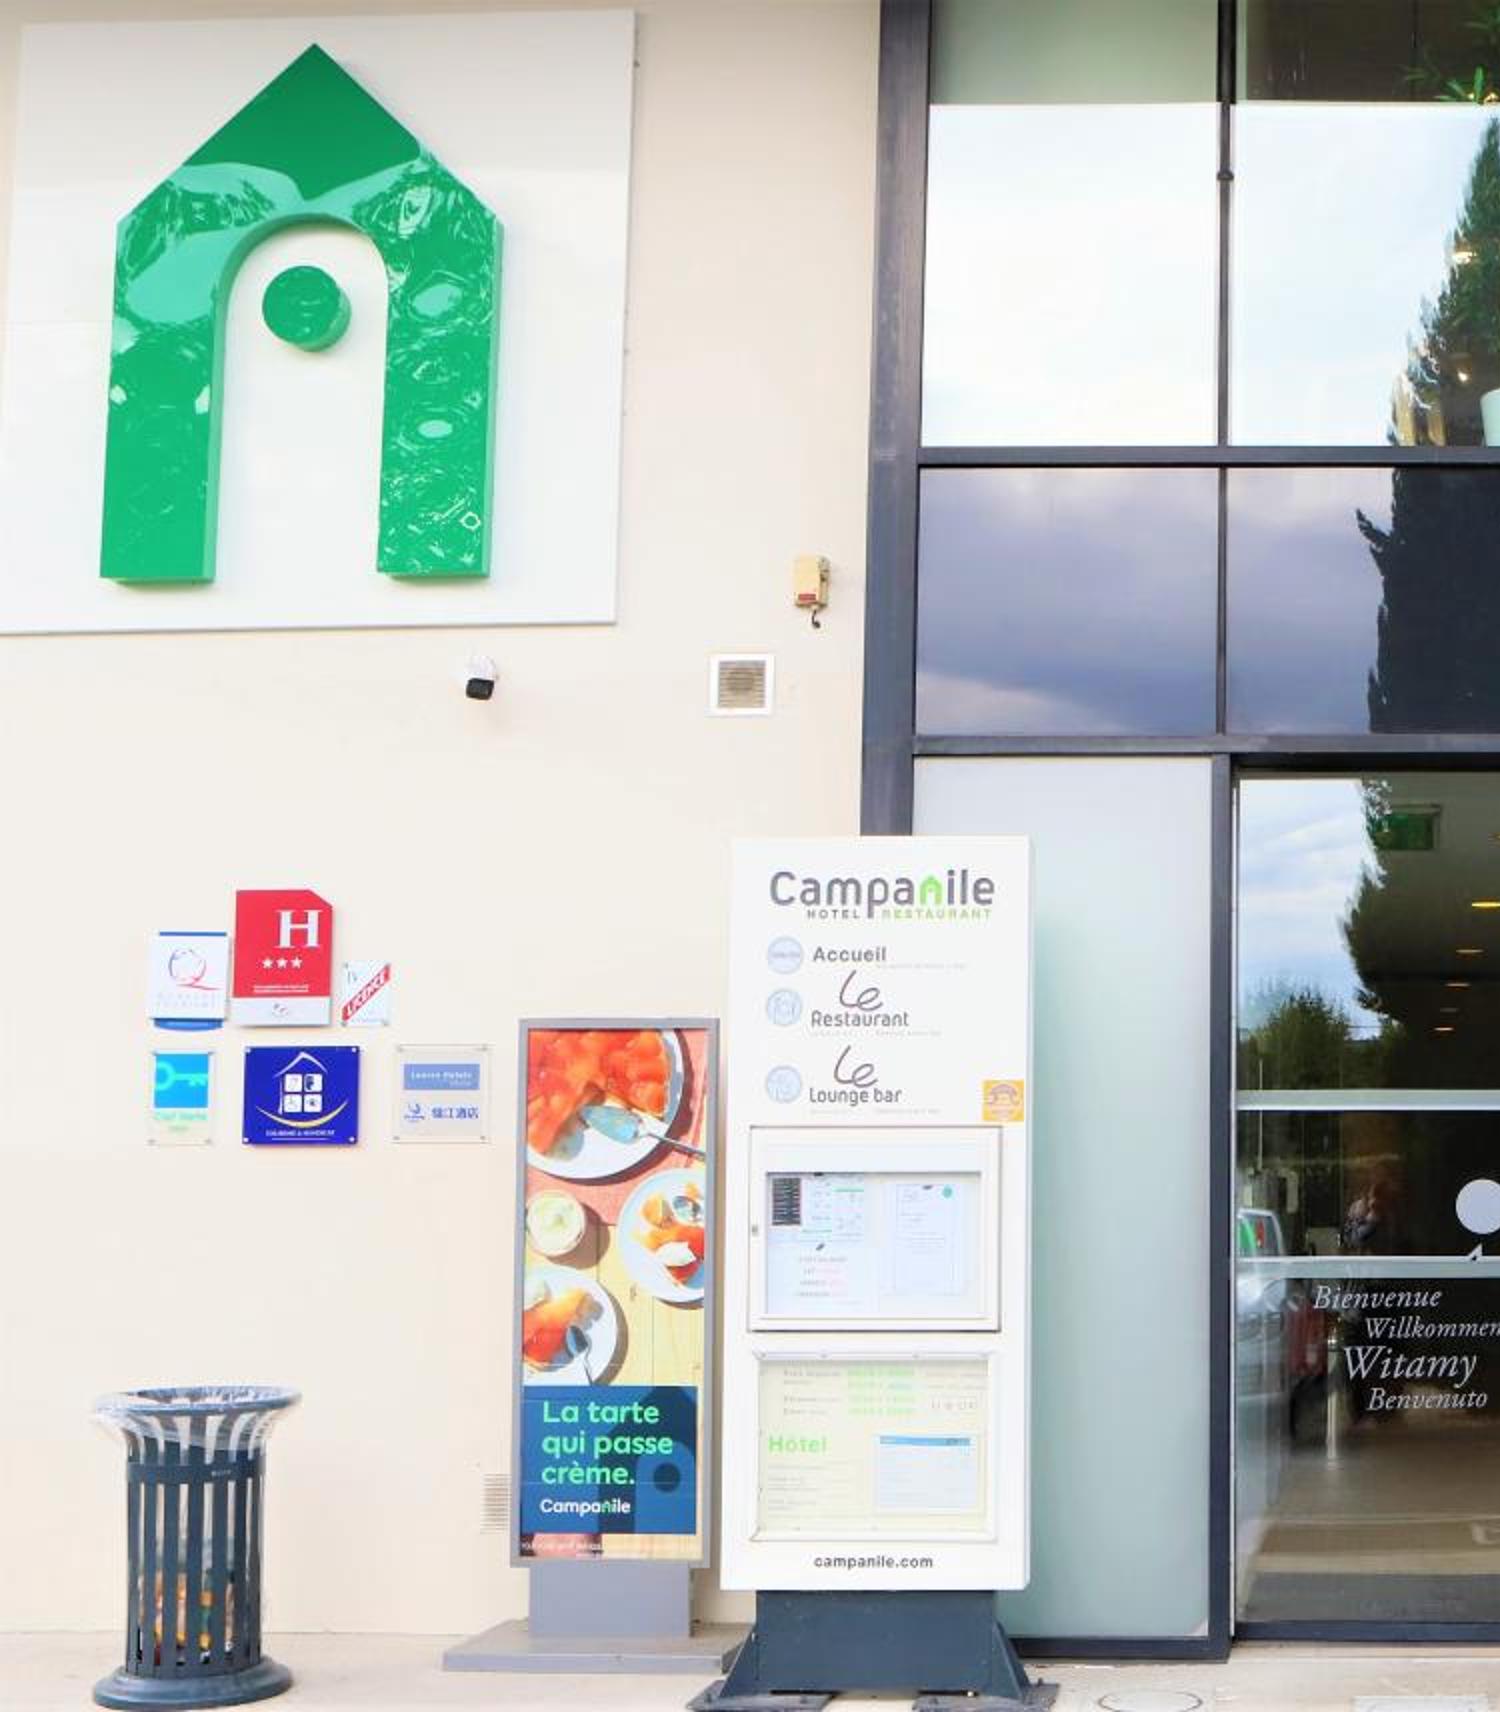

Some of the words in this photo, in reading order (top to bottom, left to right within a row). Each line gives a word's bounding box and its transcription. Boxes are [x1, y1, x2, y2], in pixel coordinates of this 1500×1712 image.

[770, 869, 995, 919] Campanile
[807, 908, 860, 919] HOTEL
[882, 907, 992, 919] RESTAURANT
[278, 910, 322, 949] H
[812, 946, 887, 962] Accueil
[811, 1010, 909, 1027] Restaurant
[809, 1088, 869, 1106] Lounge
[873, 1087, 902, 1104] bar
[1313, 1285, 1443, 1309] Bienvenue
[1344, 1345, 1478, 1389] Witamy
[1366, 1387, 1489, 1411] Benvenuto
[543, 1401, 579, 1423] La
[587, 1402, 660, 1424] tarte
[542, 1431, 584, 1458] qui
[593, 1436, 673, 1459] passe
[542, 1461, 636, 1485] crème.
[540, 1498, 632, 1517] Campanile
[814, 1555, 933, 1570] campanile.com
